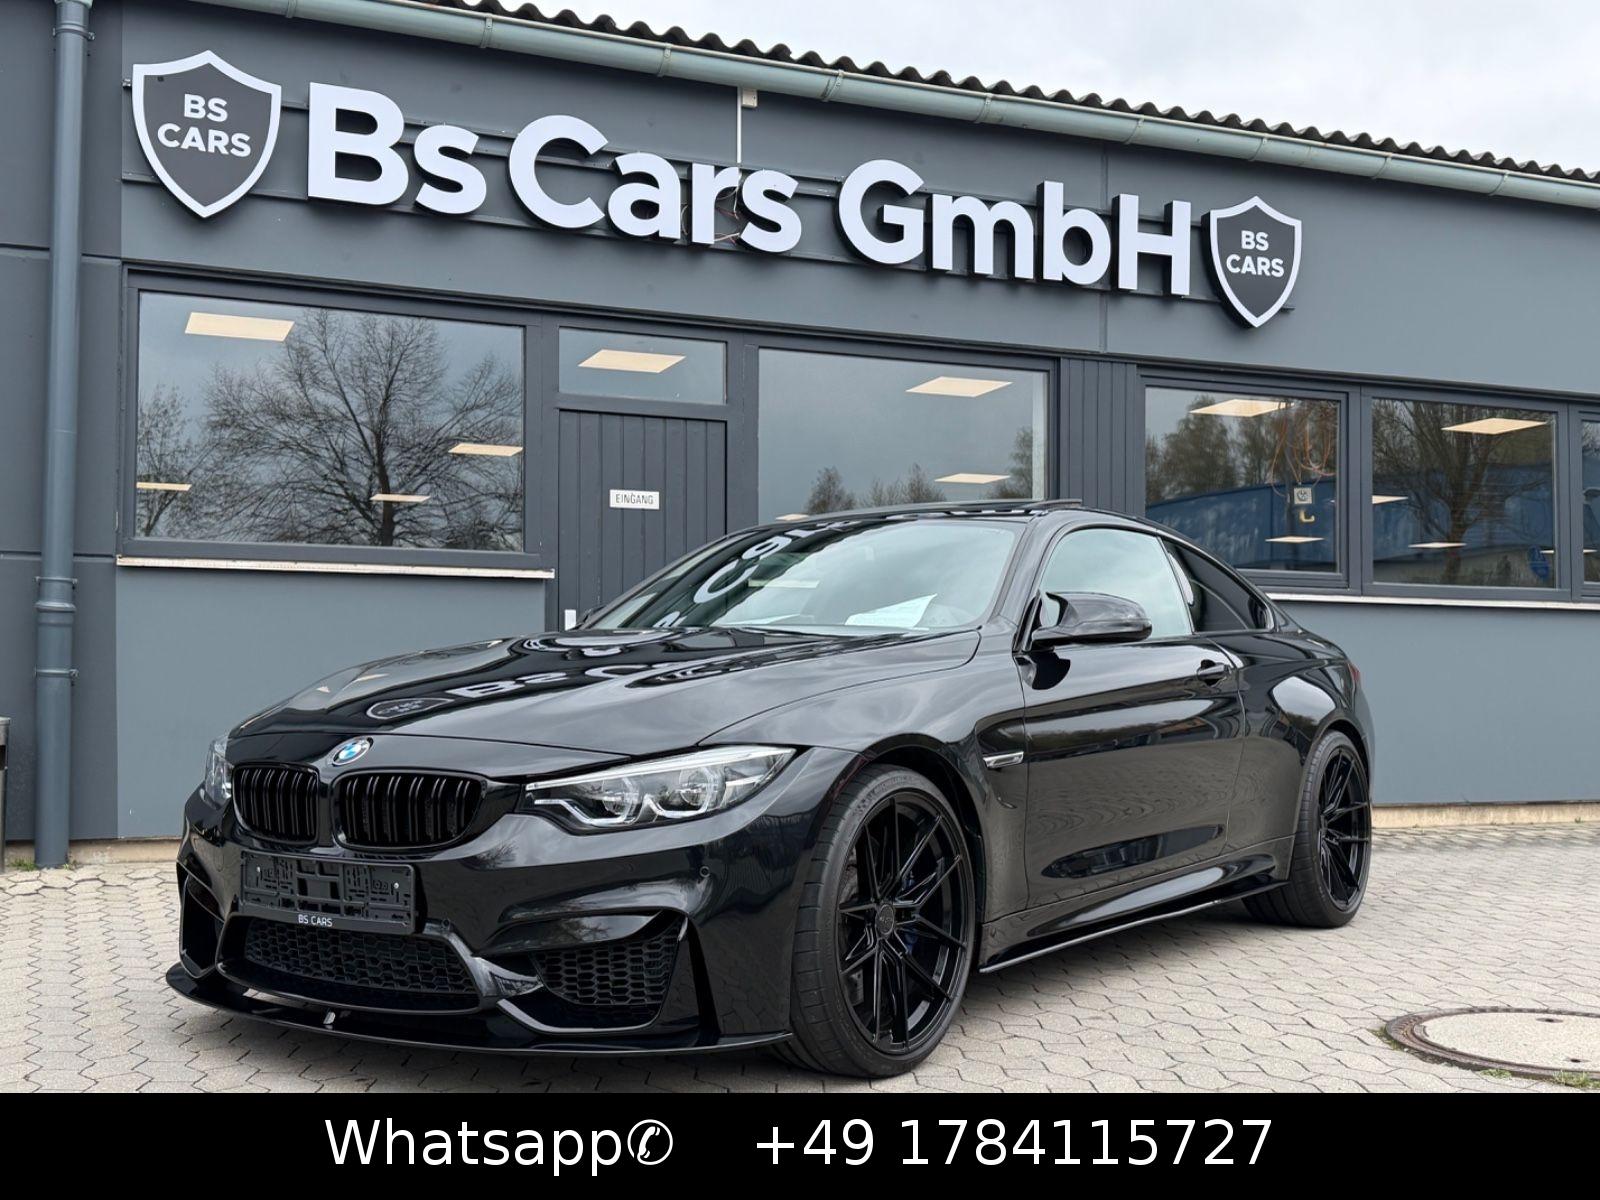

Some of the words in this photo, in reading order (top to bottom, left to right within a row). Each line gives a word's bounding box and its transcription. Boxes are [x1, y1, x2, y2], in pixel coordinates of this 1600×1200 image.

[183, 93, 229, 123] BS
[157, 122, 252, 158] CARS
[307, 81, 487, 214] Bs
[509, 114, 802, 253] Cars
[838, 159, 1192, 297] GmbH
[1241, 229, 1270, 252] BS
[1225, 253, 1285, 278] CARS
[615, 493, 654, 505] EINGANG
[298, 914, 309, 924] BS
[311, 915, 333, 927] CARS
